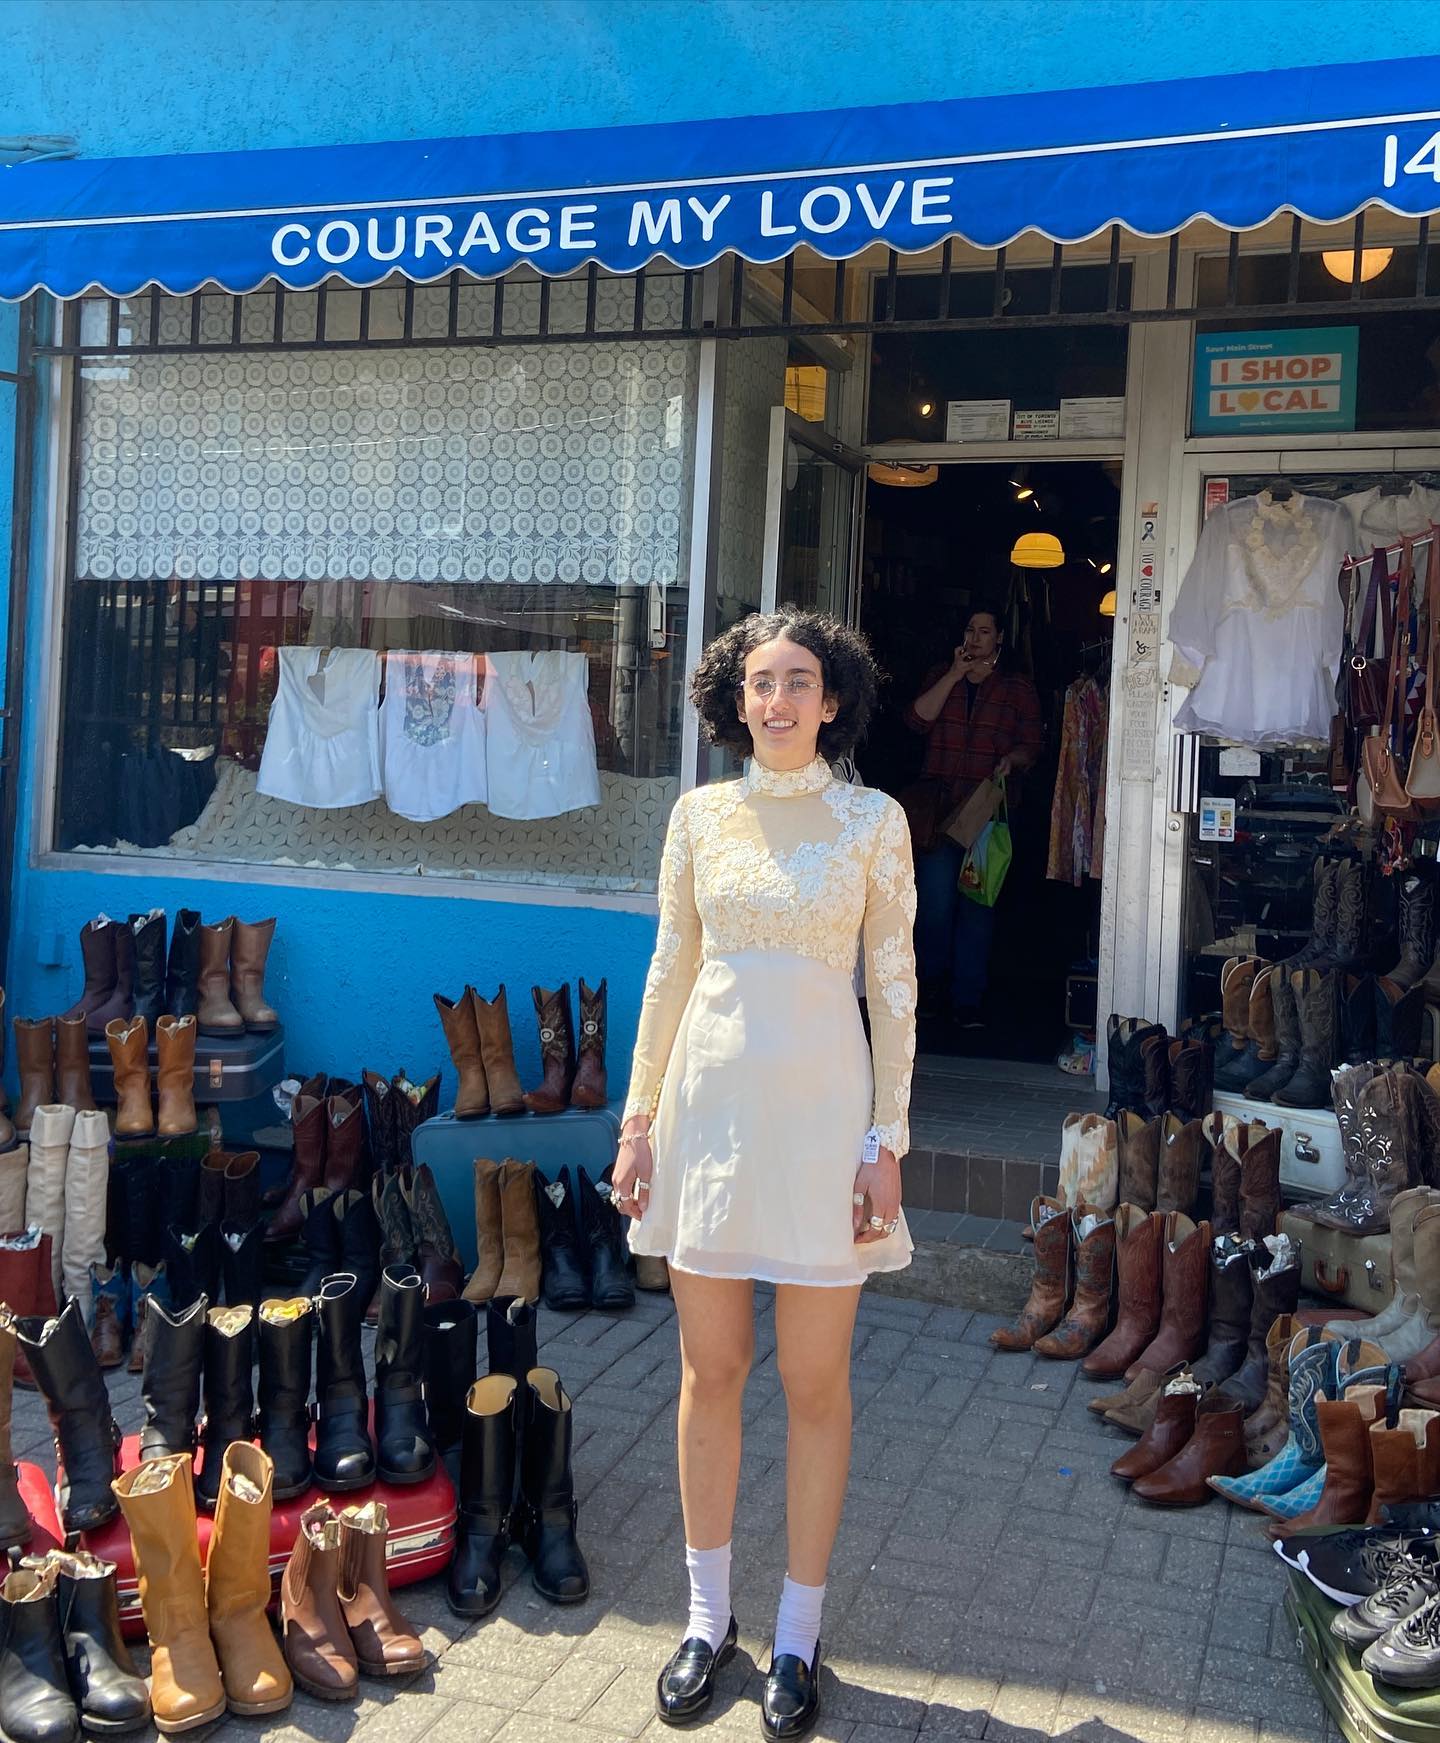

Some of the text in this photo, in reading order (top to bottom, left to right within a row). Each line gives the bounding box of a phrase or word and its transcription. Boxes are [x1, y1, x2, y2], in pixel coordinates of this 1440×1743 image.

[271, 177, 954, 267] COURAGE MY LOVE
[1226, 344, 1246, 352] Main
[1247, 343, 1273, 351] Street
[1220, 357, 1332, 383] I SHOP
[1139, 578, 1153, 612] COURAGE
